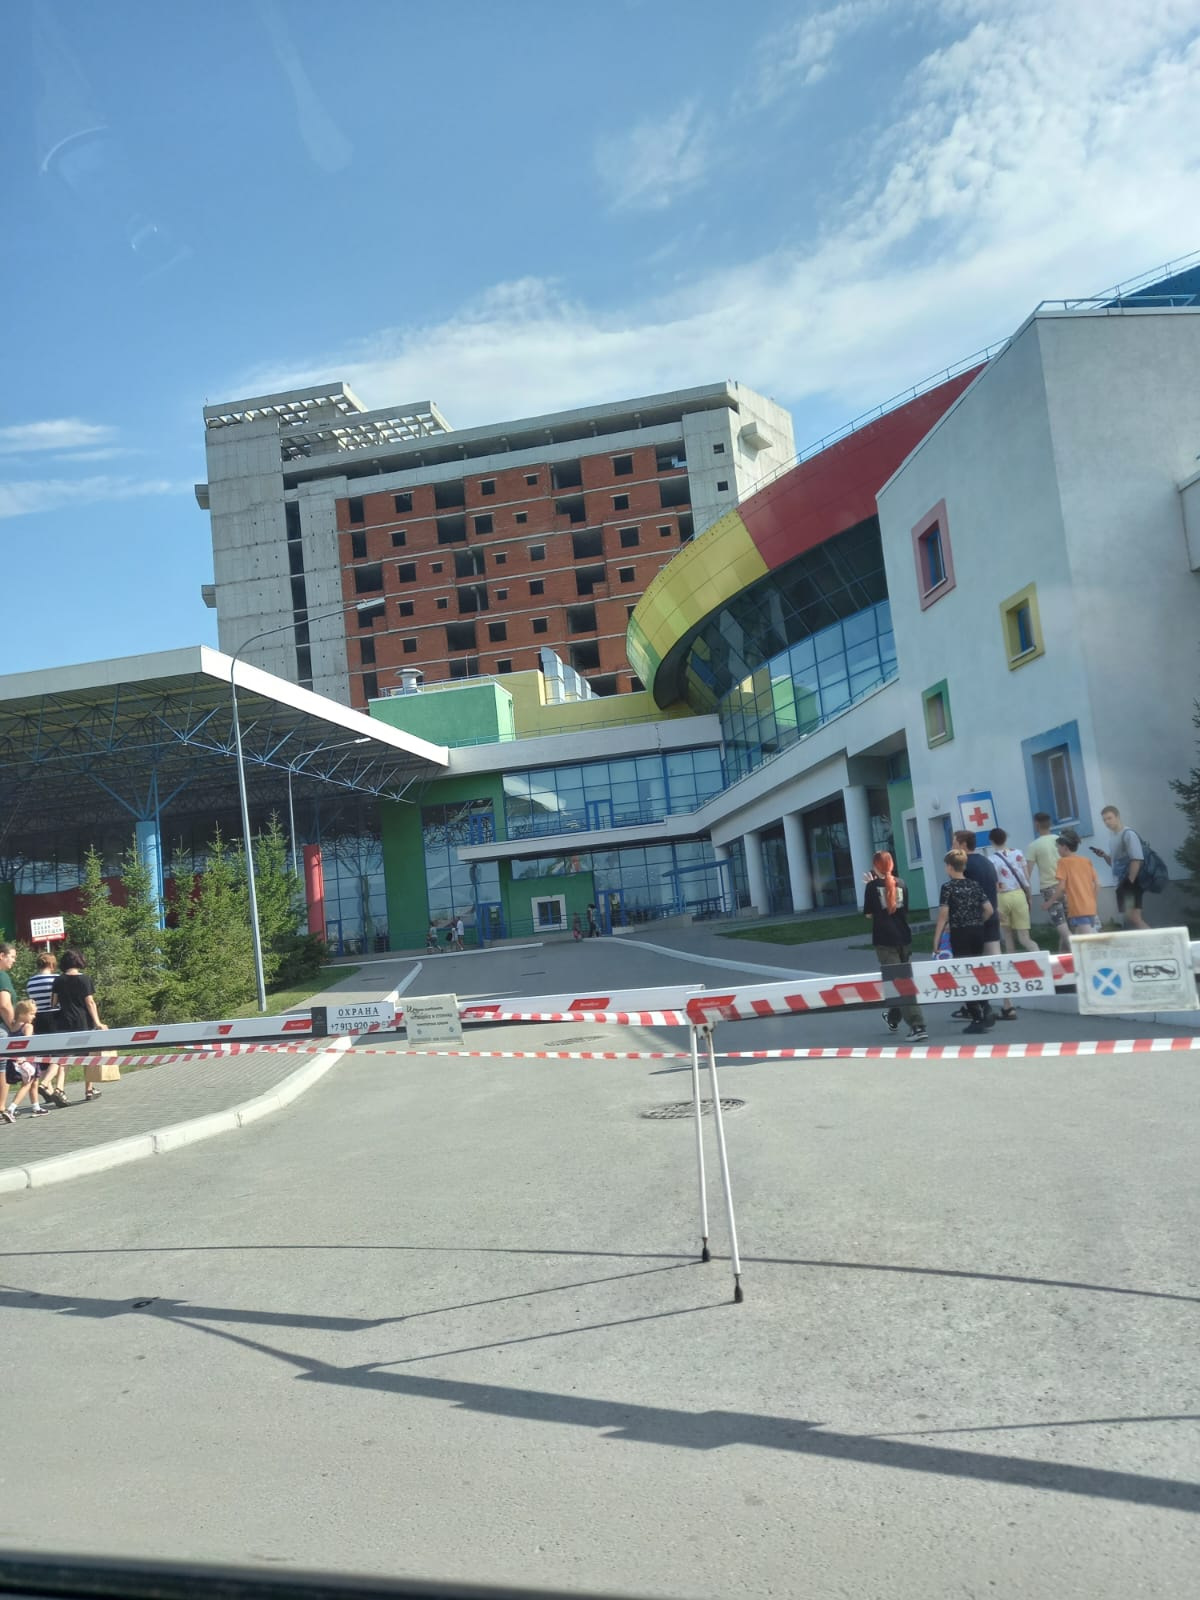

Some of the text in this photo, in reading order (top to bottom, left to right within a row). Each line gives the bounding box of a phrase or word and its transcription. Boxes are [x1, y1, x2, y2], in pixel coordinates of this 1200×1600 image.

[944, 986, 967, 998] 913
[971, 983, 998, 995] 920
[1002, 981, 1020, 993] 33
[1025, 980, 1043, 992] 62
[338, 1007, 379, 1016] ОХРАНА
[340, 1022, 352, 1030] 913
[354, 1021, 368, 1030] 920
